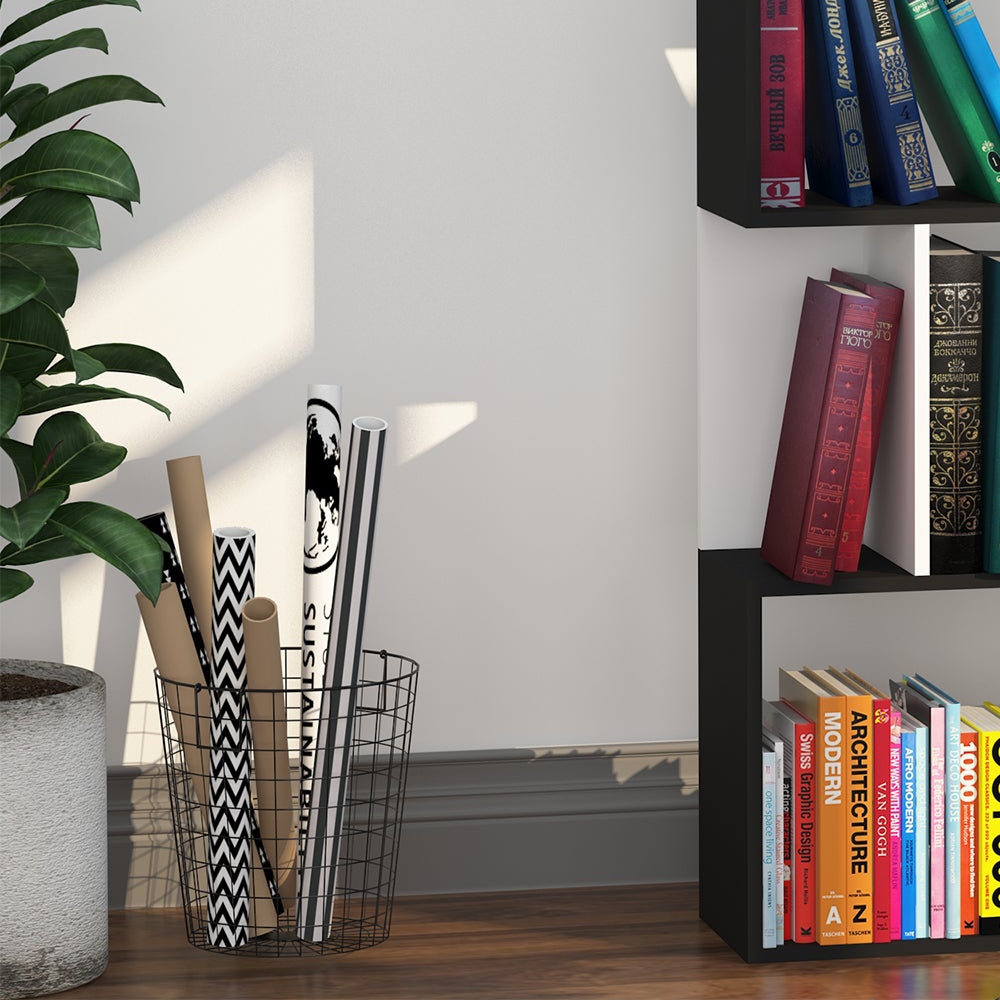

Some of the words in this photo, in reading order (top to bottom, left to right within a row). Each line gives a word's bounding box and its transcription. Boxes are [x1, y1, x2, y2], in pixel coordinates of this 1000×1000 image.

[769, 54, 786, 83] ЗОВ
[834, 44, 853, 93] Джек
[769, 87, 786, 152] ВЕЧНЫЙ
[900, 106, 910, 120] 4
[850, 133, 859, 144] 6
[991, 156, 998, 168] 1
[774, 184, 782, 198] 1
[840, 334, 872, 348] ГЮГО
[842, 327, 873, 338] ВИКТОР
[934, 339, 977, 348] ДЖОВАННИ
[933, 347, 977, 356] БОККАЧЧО
[931, 373, 979, 386] ДЕКАМЕРОН
[841, 531, 849, 543] 5
[814, 545, 824, 557] 4
[950, 726, 959, 746] ART
[800, 733, 814, 770] Swiss
[824, 711, 842, 806] MODERN
[890, 748, 900, 767] NEW
[905, 748, 914, 780] AFRO
[950, 750, 960, 781] DECO
[960, 741, 977, 803] 1000
[890, 767, 900, 790] WAYS
[798, 772, 814, 819] Graphic
[851, 710, 868, 875] ARCHITECTURE
[877, 783, 887, 810] VAN
[890, 790, 900, 812] WITH
[934, 778, 944, 817] Federico
[950, 784, 960, 822] HOUSE
[905, 782, 914, 833] MODERN
[764, 811, 773, 836] space
[890, 813, 900, 837] PAINT
[934, 818, 944, 848] Fellini
[798, 822, 814, 863] Design
[877, 815, 887, 857] GOGH
[763, 839, 774, 864] living
[825, 905, 842, 925] A
[852, 904, 867, 923] Z
[964, 920, 974, 929] K
[801, 927, 812, 936] K
